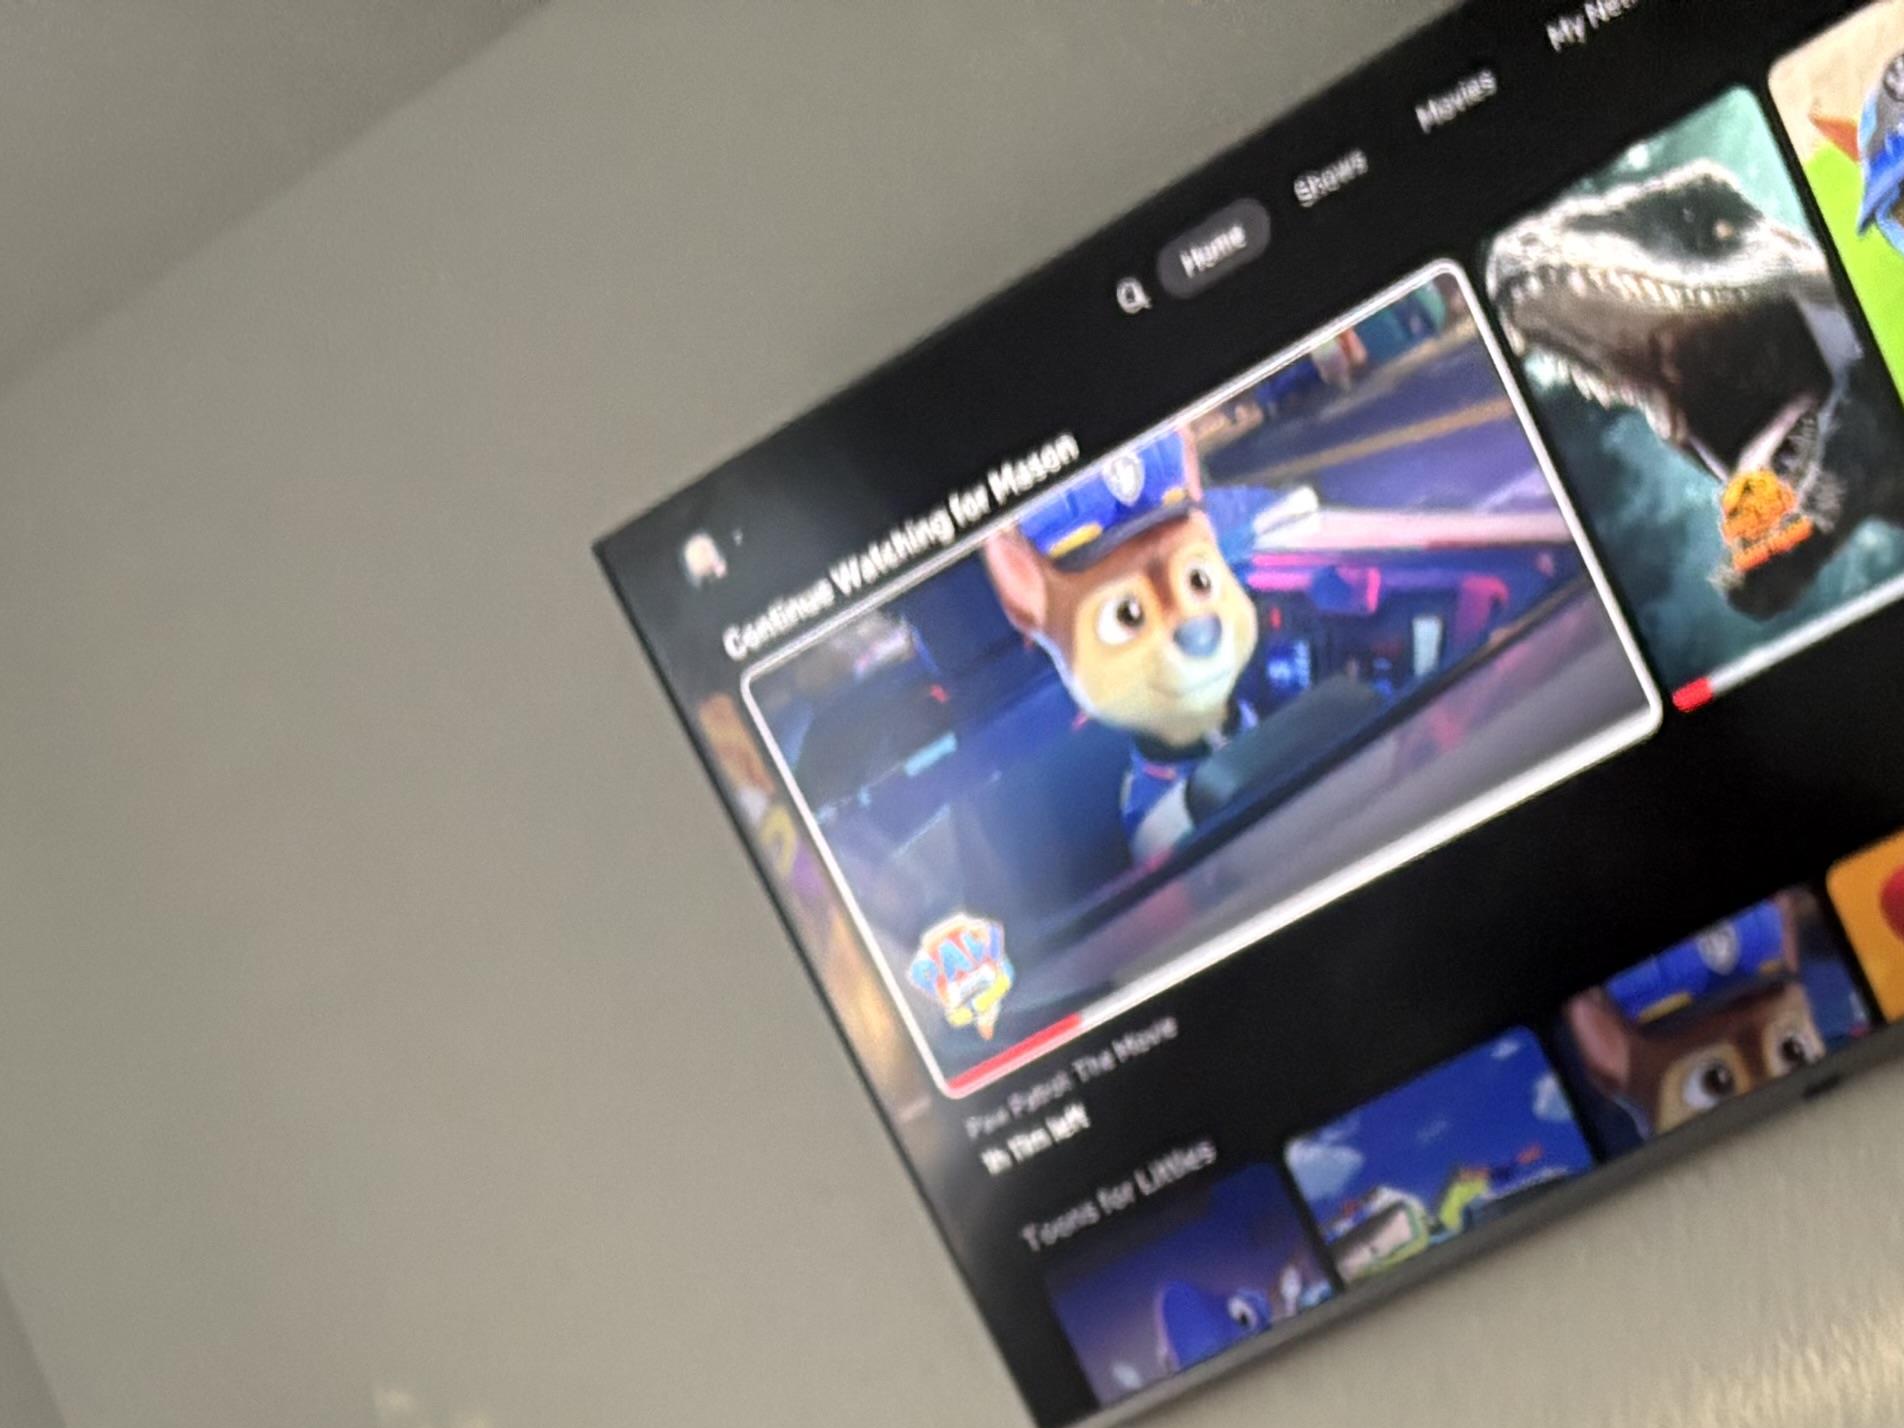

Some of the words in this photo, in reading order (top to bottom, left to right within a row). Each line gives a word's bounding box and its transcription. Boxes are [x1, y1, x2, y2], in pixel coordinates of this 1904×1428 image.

[1179, 223, 1247, 279] Home
[1293, 147, 1369, 208] Shows
[1414, 68, 1497, 135] Movies
[1546, 13, 1586, 52] My
[722, 577, 836, 661] Continue
[829, 505, 956, 597] Watching
[948, 482, 991, 527] for
[987, 433, 1080, 505] Mason
[1020, 1199, 1100, 1251] Toons
[1097, 1180, 1136, 1215] for
